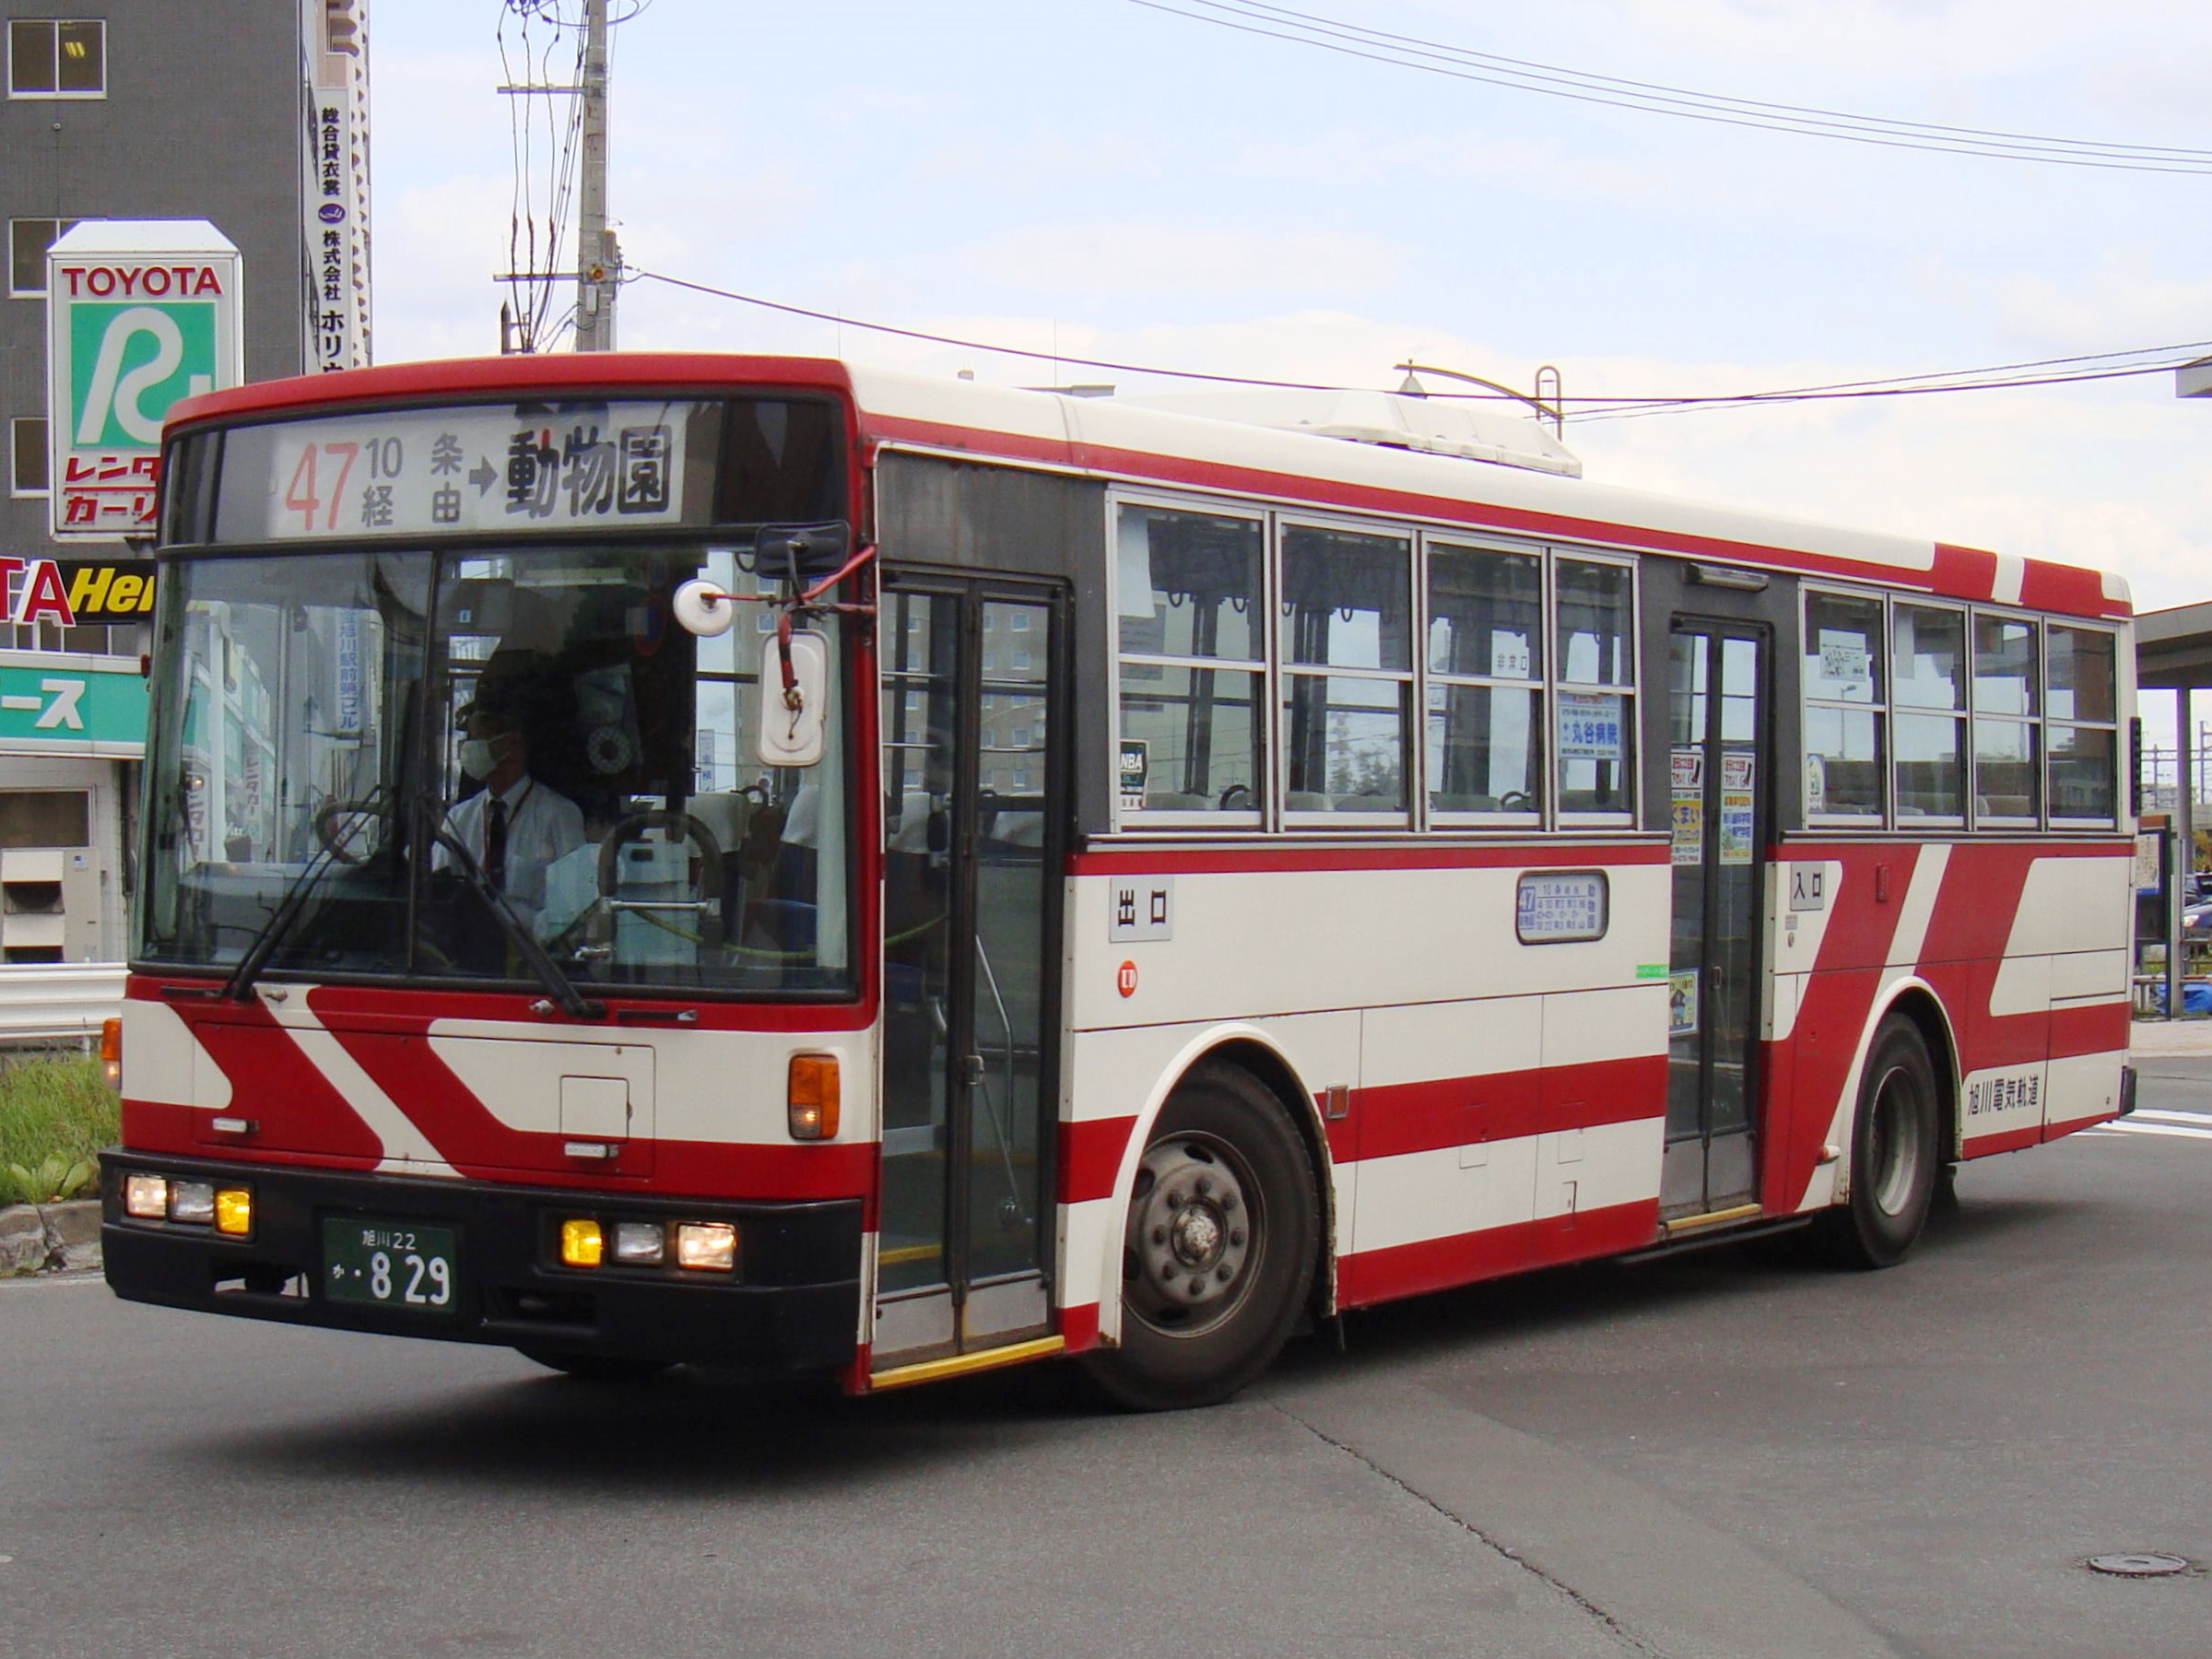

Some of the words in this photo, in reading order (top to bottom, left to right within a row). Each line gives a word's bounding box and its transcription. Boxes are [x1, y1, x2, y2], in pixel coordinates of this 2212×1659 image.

[62, 266, 222, 296] TOYOTA
[323, 229, 341, 301] 株式会社
[285, 441, 359, 531] 47
[505, 425, 673, 519] 動物園
[361, 481, 462, 527] 経由
[1118, 889, 1167, 927] 出口
[1793, 872, 1821, 900] 入口
[1967, 1074, 2039, 1116] 旭川電気軌道
